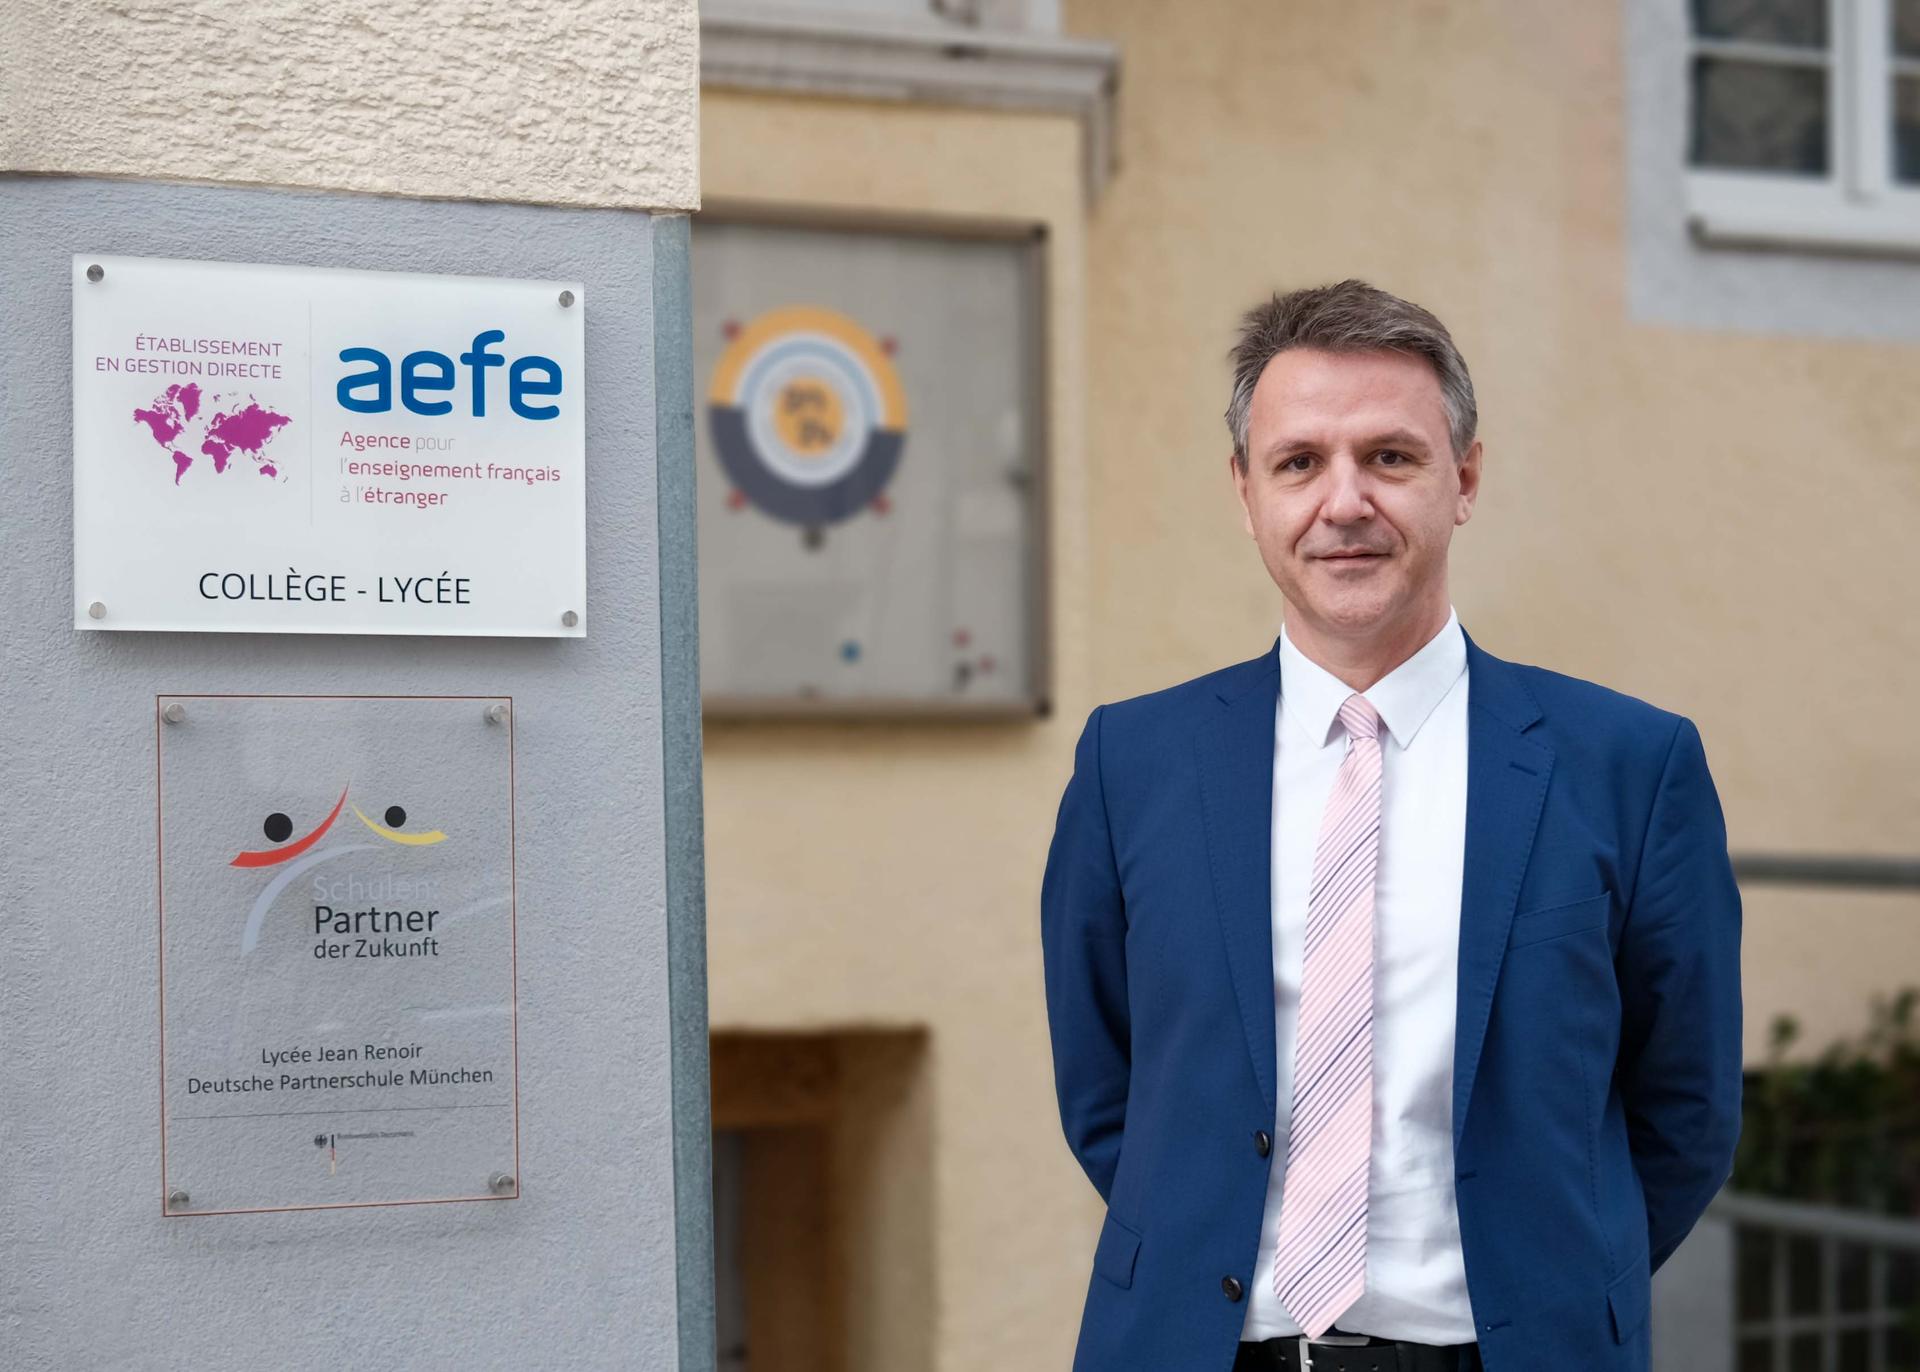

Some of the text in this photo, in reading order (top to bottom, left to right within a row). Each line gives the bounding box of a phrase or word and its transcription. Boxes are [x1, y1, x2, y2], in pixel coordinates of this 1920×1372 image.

[136, 333, 282, 357] ÉTABLISSEMENT
[96, 357, 282, 379] EN GESTION DIRECTE
[337, 329, 563, 421] aefe
[340, 431, 456, 453] Agence pour
[340, 456, 561, 485] l'enseignement français
[340, 486, 448, 509] à l'étranger
[199, 567, 346, 602] COLLÈGE
[379, 571, 471, 604] LYCÉE
[315, 906, 440, 934] Partner
[314, 937, 439, 959] der Zukunft
[262, 1043, 423, 1067] Lycée Jean Renoir
[188, 1066, 493, 1094] Deutsche Partnerschule München
